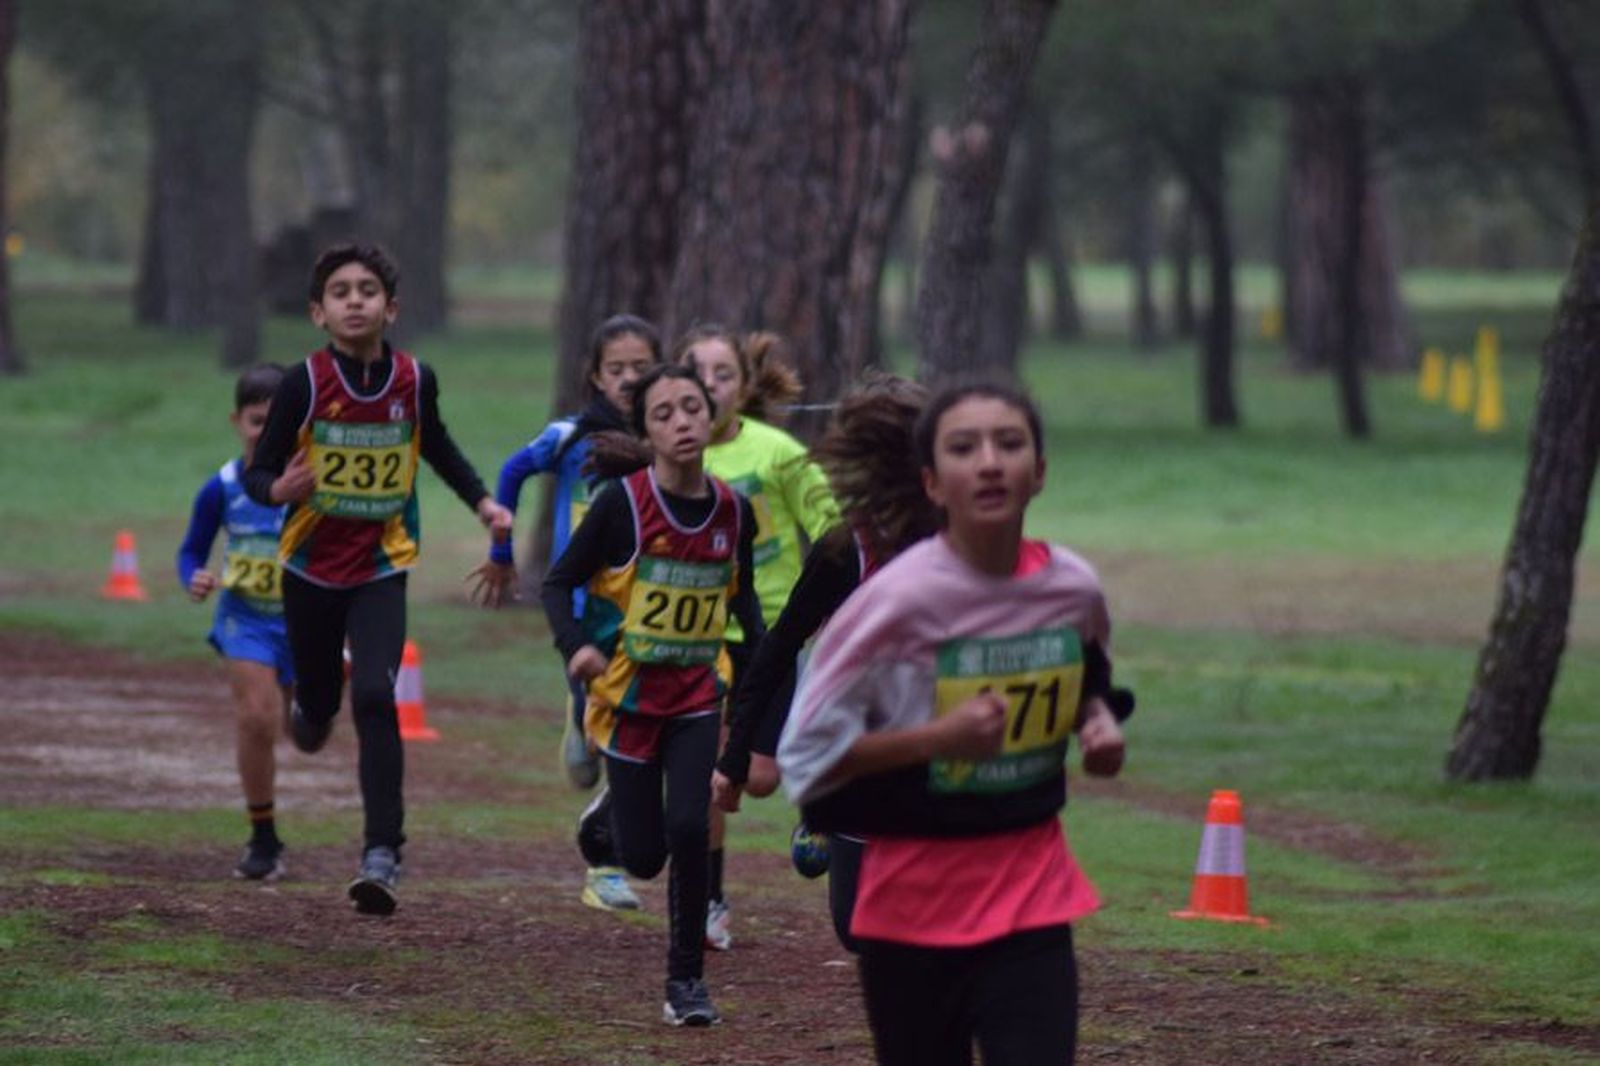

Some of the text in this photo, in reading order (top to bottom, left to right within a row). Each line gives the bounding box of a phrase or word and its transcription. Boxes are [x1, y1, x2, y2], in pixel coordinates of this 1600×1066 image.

[322, 451, 401, 490] 232
[232, 559, 276, 595] 23
[641, 590, 720, 633] 207
[978, 676, 1060, 742] 71
